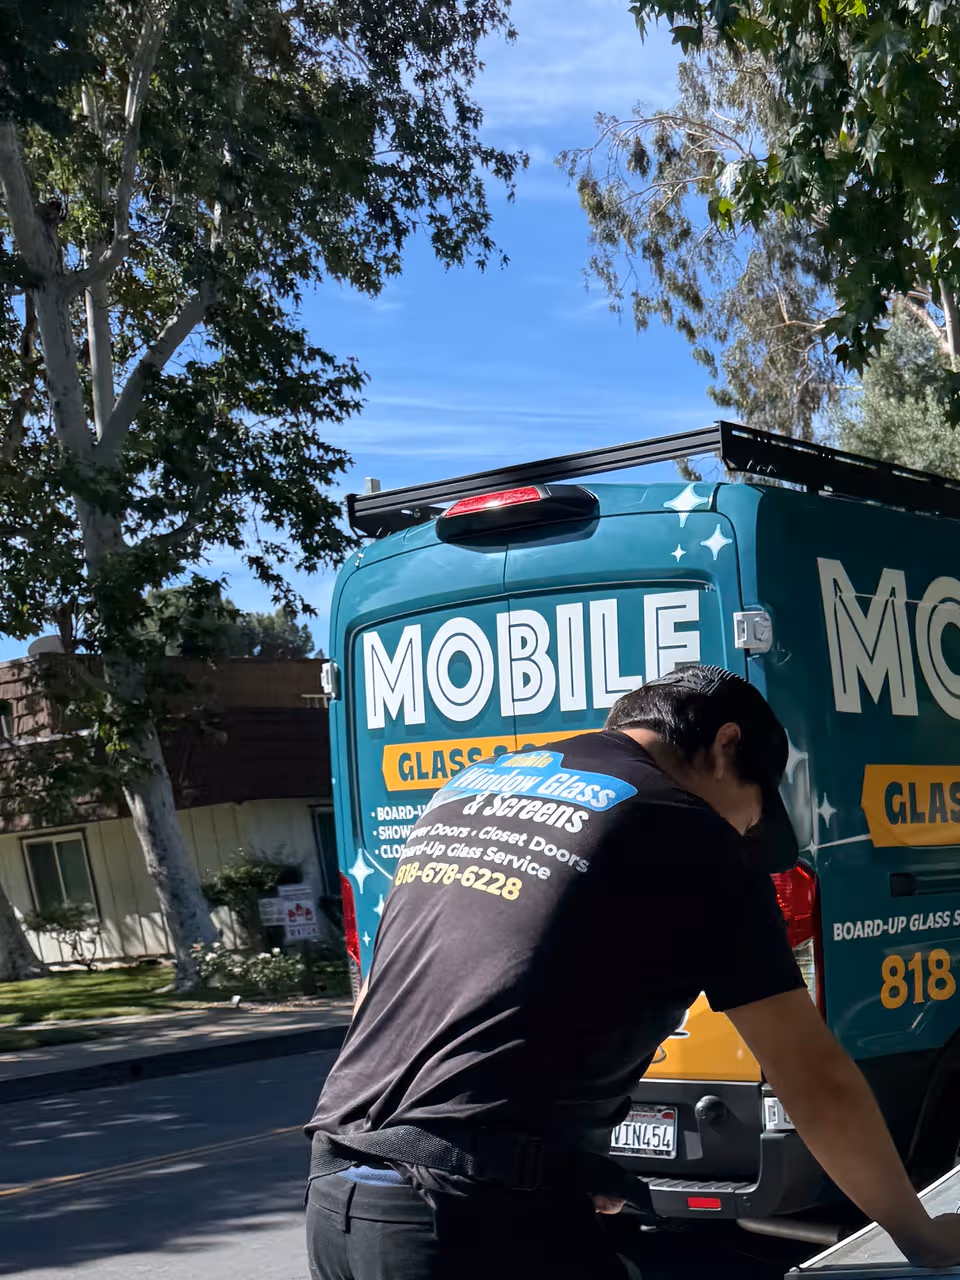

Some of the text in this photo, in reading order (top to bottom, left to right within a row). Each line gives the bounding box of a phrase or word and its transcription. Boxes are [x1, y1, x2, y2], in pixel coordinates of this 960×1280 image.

[363, 590, 700, 730] MOBILE
[452, 767, 616, 808] Window Glass
[463, 790, 589, 833] & Screens
[378, 825, 414, 840] SHOW
[429, 823, 471, 838] Doors
[479, 826, 528, 847] Closet
[528, 835, 590, 873] Doors
[394, 861, 523, 901] 818-678-6228
[447, 842, 484, 858] Glass
[483, 846, 551, 880] Service
[833, 916, 907, 941] BOARD-UP
[909, 910, 950, 931] GLASS
[880, 948, 956, 1010] 818
[613, 1123, 670, 1149] VIN454
